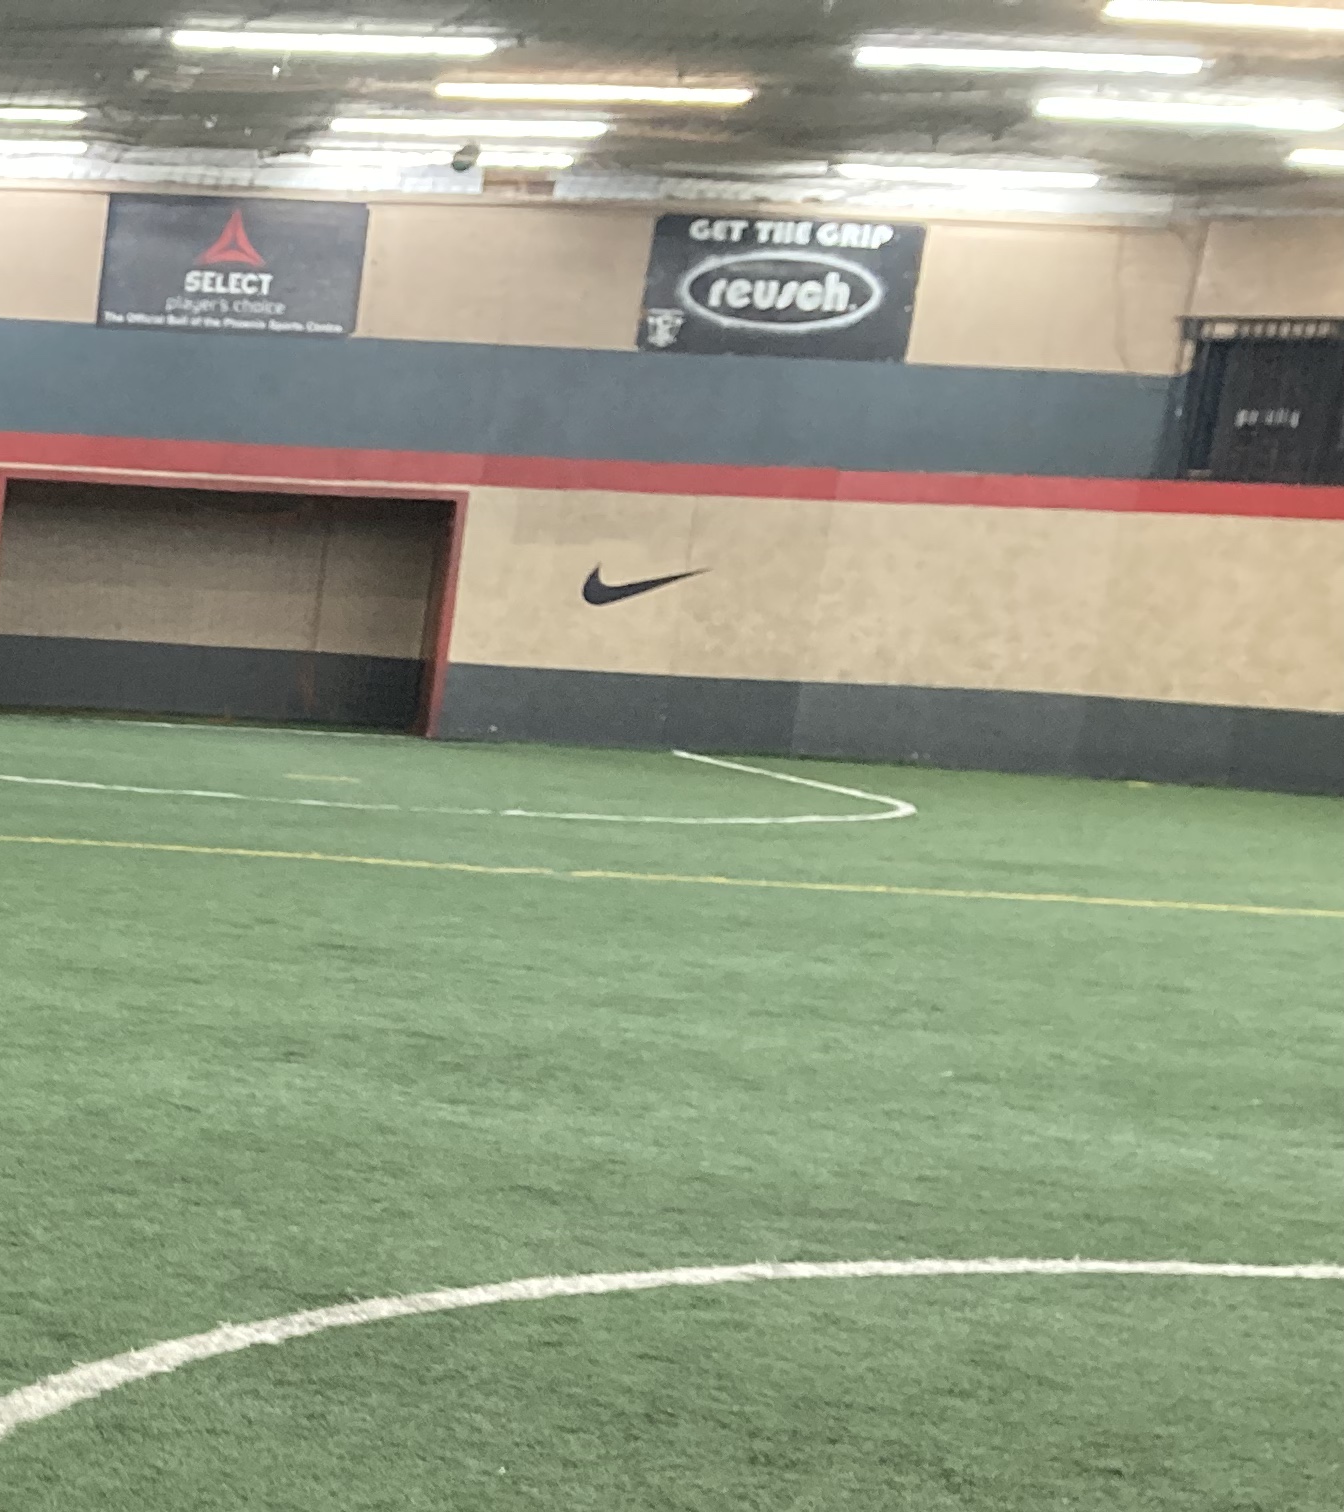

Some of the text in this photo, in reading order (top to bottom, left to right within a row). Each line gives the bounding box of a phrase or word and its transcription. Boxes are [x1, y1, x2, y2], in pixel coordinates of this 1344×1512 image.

[688, 218, 894, 249] GET THE GRIP
[184, 269, 274, 296] SELECT
